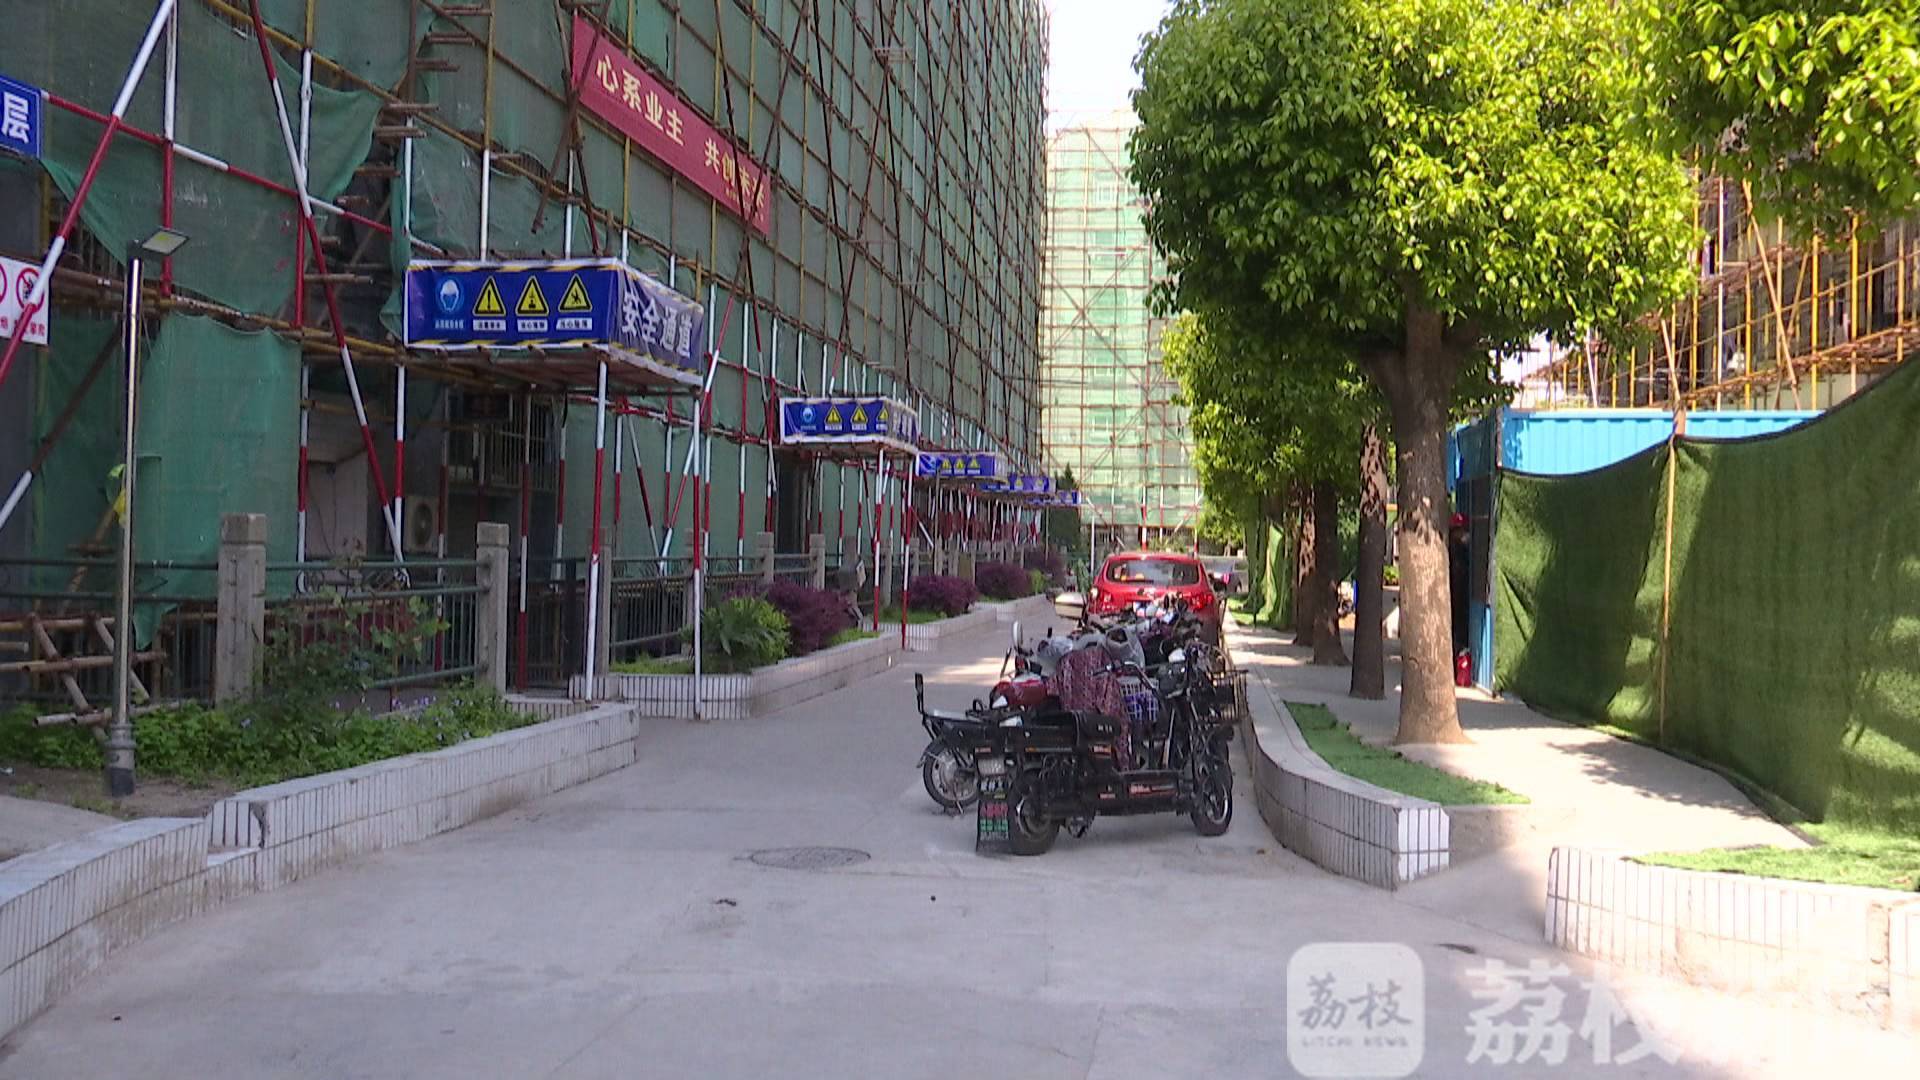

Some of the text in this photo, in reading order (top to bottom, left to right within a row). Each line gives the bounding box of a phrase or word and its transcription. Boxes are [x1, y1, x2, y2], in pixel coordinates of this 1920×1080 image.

[1, 91, 31, 144] 层
[596, 55, 684, 146] 心系业主
[622, 290, 693, 359] 安全通道
